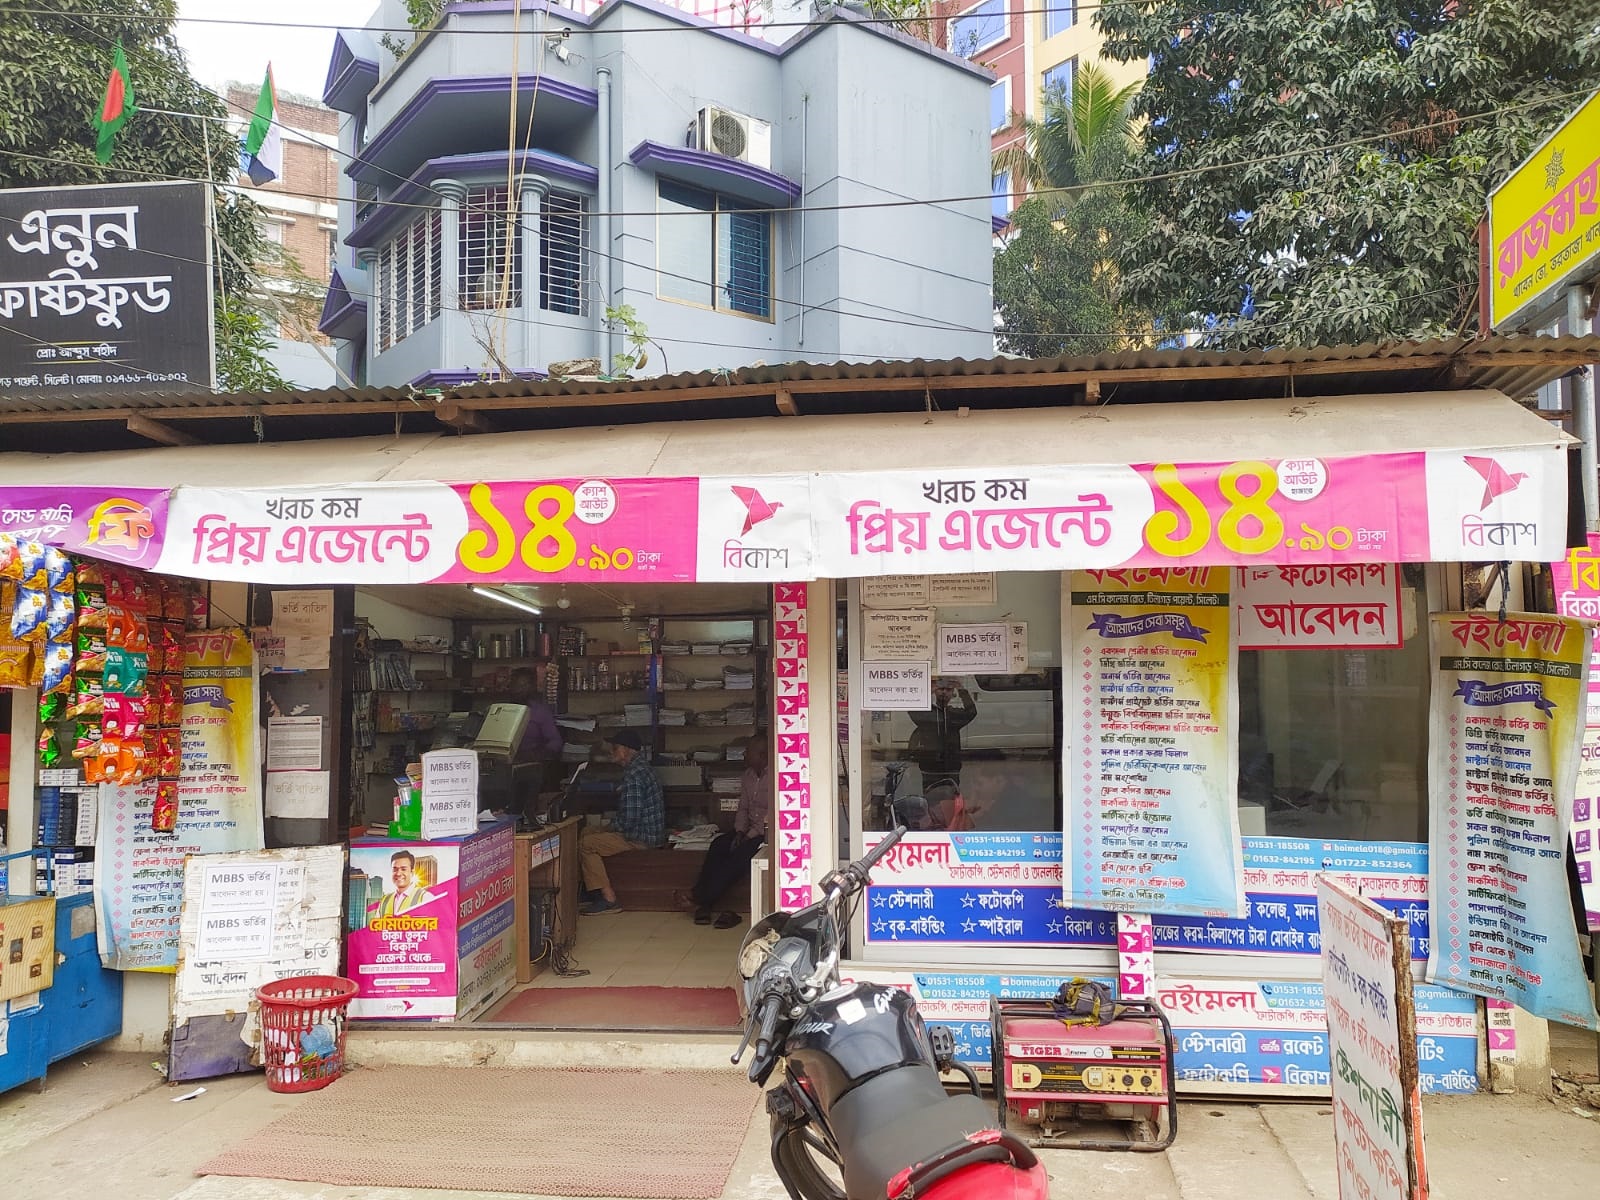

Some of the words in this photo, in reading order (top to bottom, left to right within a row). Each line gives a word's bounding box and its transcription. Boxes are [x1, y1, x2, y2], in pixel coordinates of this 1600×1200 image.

[7, 206, 139, 270] এনুন
[93, 343, 117, 356] শহীদ
[1286, 460, 1315, 471] ক্যাশ
[1284, 472, 1318, 485] আউট
[582, 486, 607, 497] ক্যাশ
[923, 480, 975, 504] খরচ
[985, 478, 1030, 501] কম
[266, 498, 314, 521] খরচ
[321, 498, 362, 519] কম
[580, 498, 609, 510] আউট
[1144, 461, 1354, 559] ১৪.৯০
[2, 508, 37, 525] সেন্ড
[40, 504, 73, 523] মানি
[80, 498, 155, 550] ফ্রি
[459, 483, 634, 574] ১৪.৯০
[846, 500, 930, 555] প্রিয়
[939, 493, 1113, 551] এজেন্টে
[1461, 514, 1537, 548] বিকাশ
[192, 514, 270, 566] প্রিয়
[276, 513, 432, 564] এজেন্টে
[1357, 528, 1388, 542] টাকা
[637, 550, 663, 563] টাকা
[724, 539, 789, 569] বিকাশ
[1106, 619, 1143, 635] আমাদের
[1145, 615, 1163, 630] সেবা
[1165, 615, 1185, 632] সমূহ
[1252, 600, 1388, 637] আবেদন
[946, 634, 977, 643] MBBS
[979, 633, 1001, 642] ভর্তির
[1450, 613, 1567, 653] বইমেলা
[869, 670, 899, 679] MBBS
[902, 669, 923, 679] ভর্তির
[1504, 686, 1522, 698] সেবা
[1509, 718, 1529, 730] ভর্তির
[1465, 741, 1488, 751] অনার্স
[1504, 747, 1530, 757] আবেদন
[430, 763, 453, 772] MBBS
[455, 761, 471, 770] ভর্তির
[1504, 761, 1532, 771] আবেদন
[1510, 773, 1529, 786] ভর্তির
[1466, 782, 1489, 794] উন্মুক্ত
[1525, 789, 1549, 801] ভর্তির
[430, 802, 453, 810] MBBS
[455, 800, 471, 808] ভর্তির
[1466, 807, 1483, 817] ভর্তি
[1508, 817, 1534, 827] আবেদন
[1467, 822, 1487, 831] সকল
[1523, 831, 1550, 844] ফিলাপ
[1467, 834, 1490, 846] পুলিশ
[1249, 841, 1310, 850] 01531-185508
[969, 849, 1025, 857] 01632-842195
[1467, 849, 1481, 858] নাম
[1253, 855, 1315, 865] 01632-842195
[1334, 859, 1412, 869] 01722-852364
[211, 873, 245, 884] MBBS
[247, 872, 271, 882] ভর্তির
[210, 889, 237, 897] আবেদন
[460, 900, 473, 918] মাত্র
[475, 881, 501, 910] ১৮০০
[888, 888, 934, 910] স্টেশনারী
[978, 889, 1024, 910] ফটোকপি
[1257, 900, 1290, 922] কলেজ,
[207, 918, 240, 929] MBBS
[242, 916, 266, 927] ভর্তির
[369, 915, 438, 931] রেমিটেন্সের
[888, 916, 945, 940] বুক-বাইন্ডিং
[979, 916, 1024, 936] স্পাইরাল
[1064, 915, 1093, 936] বিকাশ
[206, 935, 232, 944] আবেদন
[382, 930, 402, 941] টাকা
[405, 931, 428, 943] তুলুন
[1183, 922, 1245, 945] ফরম-ফিলাপের
[1248, 926, 1266, 947] টাকা
[1271, 927, 1304, 949] মোবাইল
[1521, 930, 1547, 943] আবেদন
[389, 941, 418, 952] বিকাশ
[1469, 941, 1483, 952] ছবি
[1487, 946, 1505, 956] থেকে
[376, 952, 406, 963] এজেন্ট
[408, 953, 431, 962] থেকে
[928, 977, 985, 986] 01531-185508
[931, 989, 990, 998] 01632-842195
[1158, 984, 1257, 1014] বইমেলা
[1182, 1032, 1246, 1054] স্টেশনারী
[1283, 1036, 1324, 1055] রকেট
[1022, 1046, 1062, 1055] TIGER
